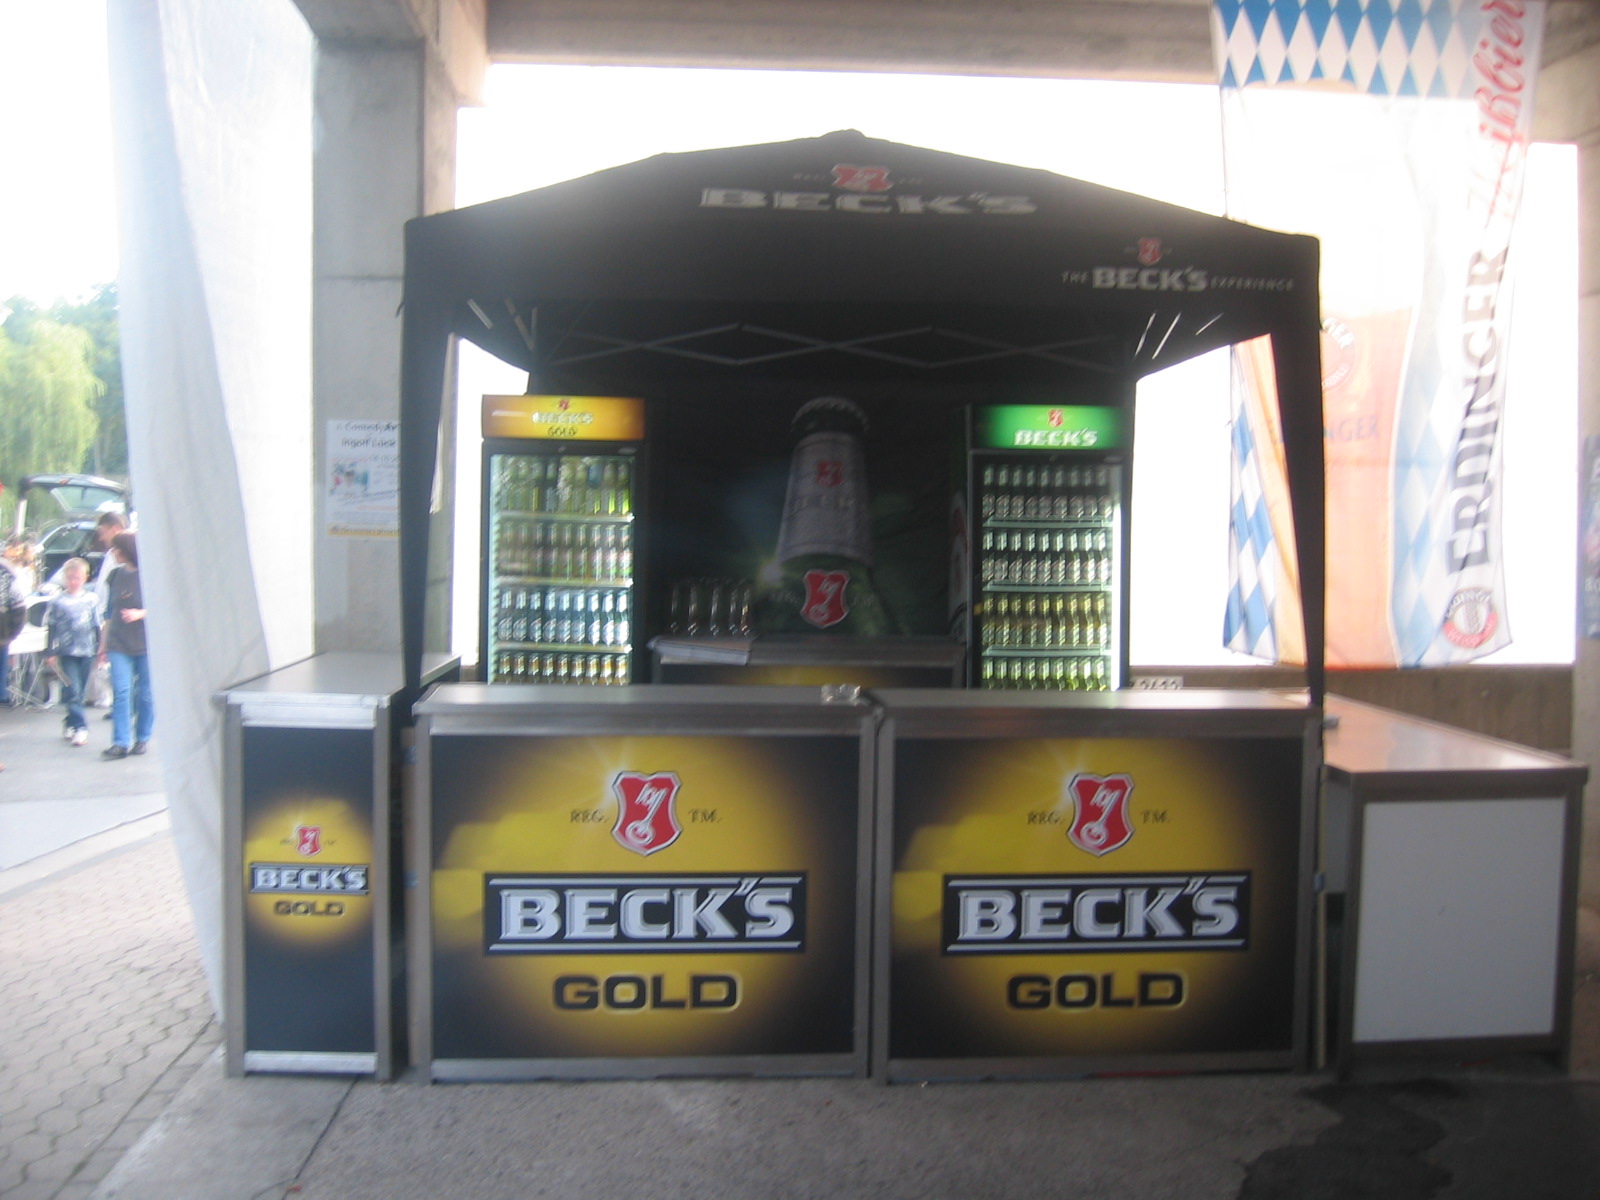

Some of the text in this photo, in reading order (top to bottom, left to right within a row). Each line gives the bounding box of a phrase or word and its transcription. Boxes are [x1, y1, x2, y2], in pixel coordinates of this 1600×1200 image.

[700, 187, 1037, 215] BECK'S
[1061, 265, 1295, 292] THE BECK'S EXPERIENCE
[532, 411, 594, 424] BECK'S
[1445, 238, 1510, 575] ERDINGER
[548, 426, 577, 436] GOLD
[1013, 427, 1099, 447] BECK'S
[254, 866, 367, 890] BECK'S
[275, 901, 344, 916] GOLD
[499, 877, 795, 940] BECK'S
[956, 876, 1239, 941] BECK'S
[554, 974, 739, 1011] GOLD
[1007, 972, 1185, 1010] GOLD
